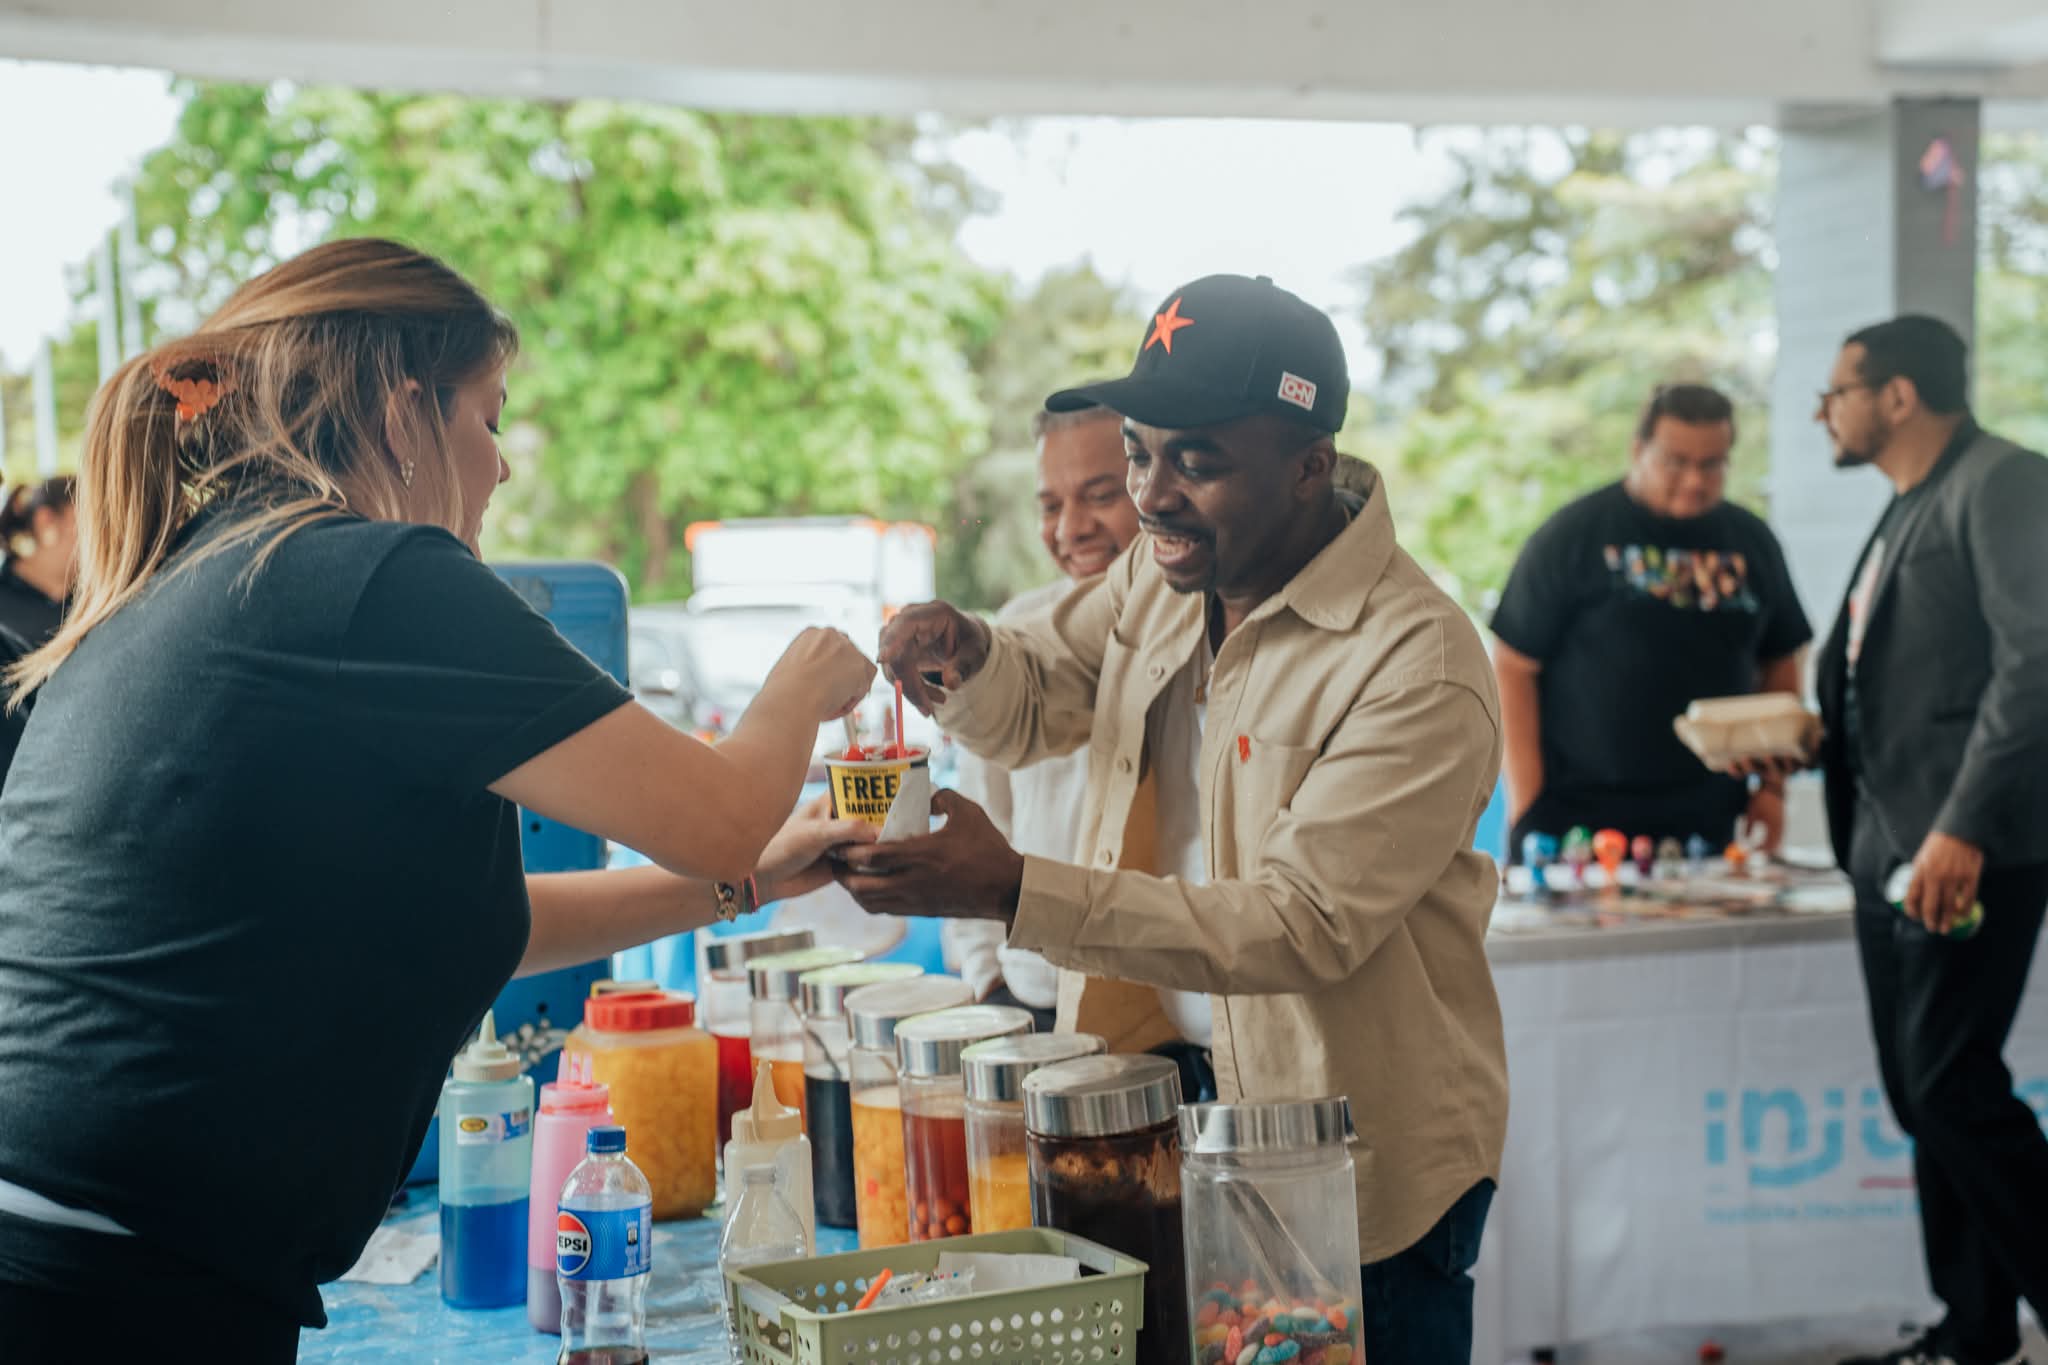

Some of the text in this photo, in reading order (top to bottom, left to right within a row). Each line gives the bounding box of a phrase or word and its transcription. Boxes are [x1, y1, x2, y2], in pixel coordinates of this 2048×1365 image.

[842, 775, 897, 800] FREE
[845, 802, 892, 814] BARBECU
[558, 1235, 588, 1252] EPSI
